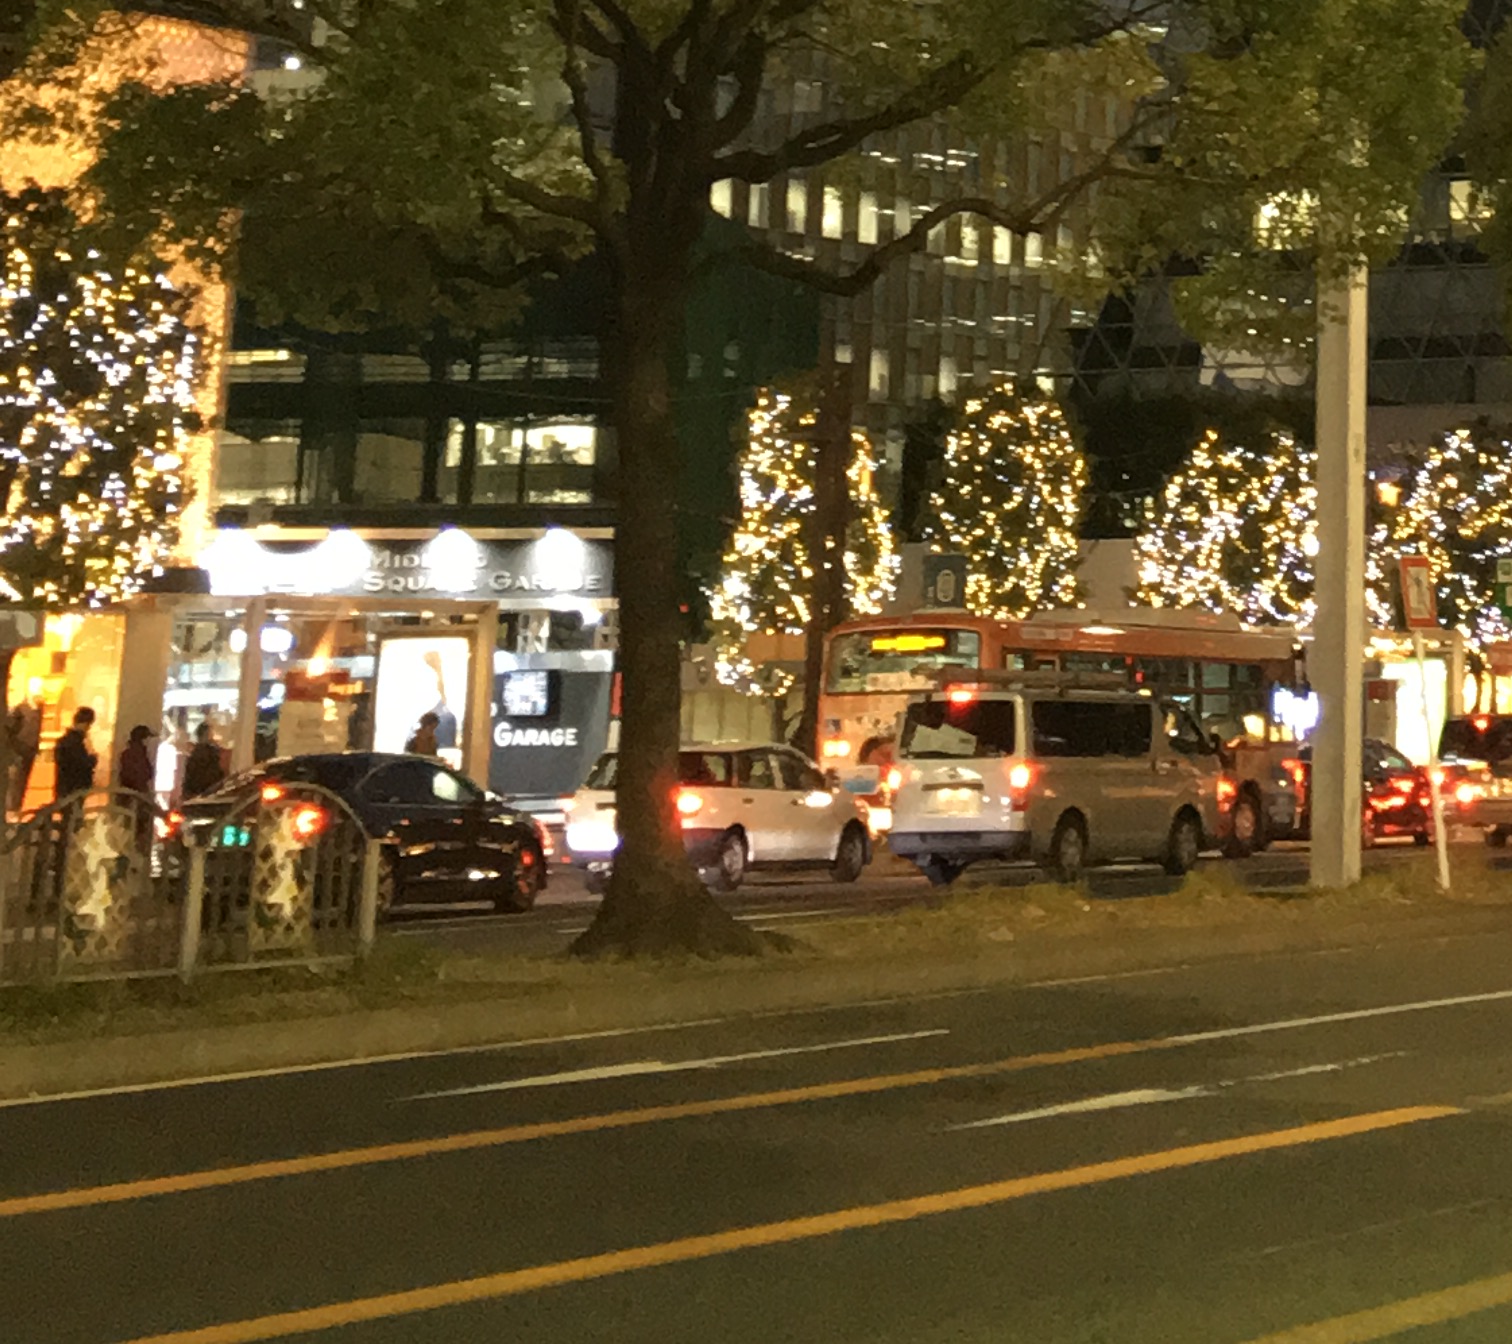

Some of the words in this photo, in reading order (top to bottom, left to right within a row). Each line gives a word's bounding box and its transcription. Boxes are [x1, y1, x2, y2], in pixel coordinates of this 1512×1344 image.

[370, 550, 488, 569] MIDLD
[362, 570, 479, 593] SQU
[488, 570, 603, 591] GARE
[493, 721, 579, 748] GARAGE
